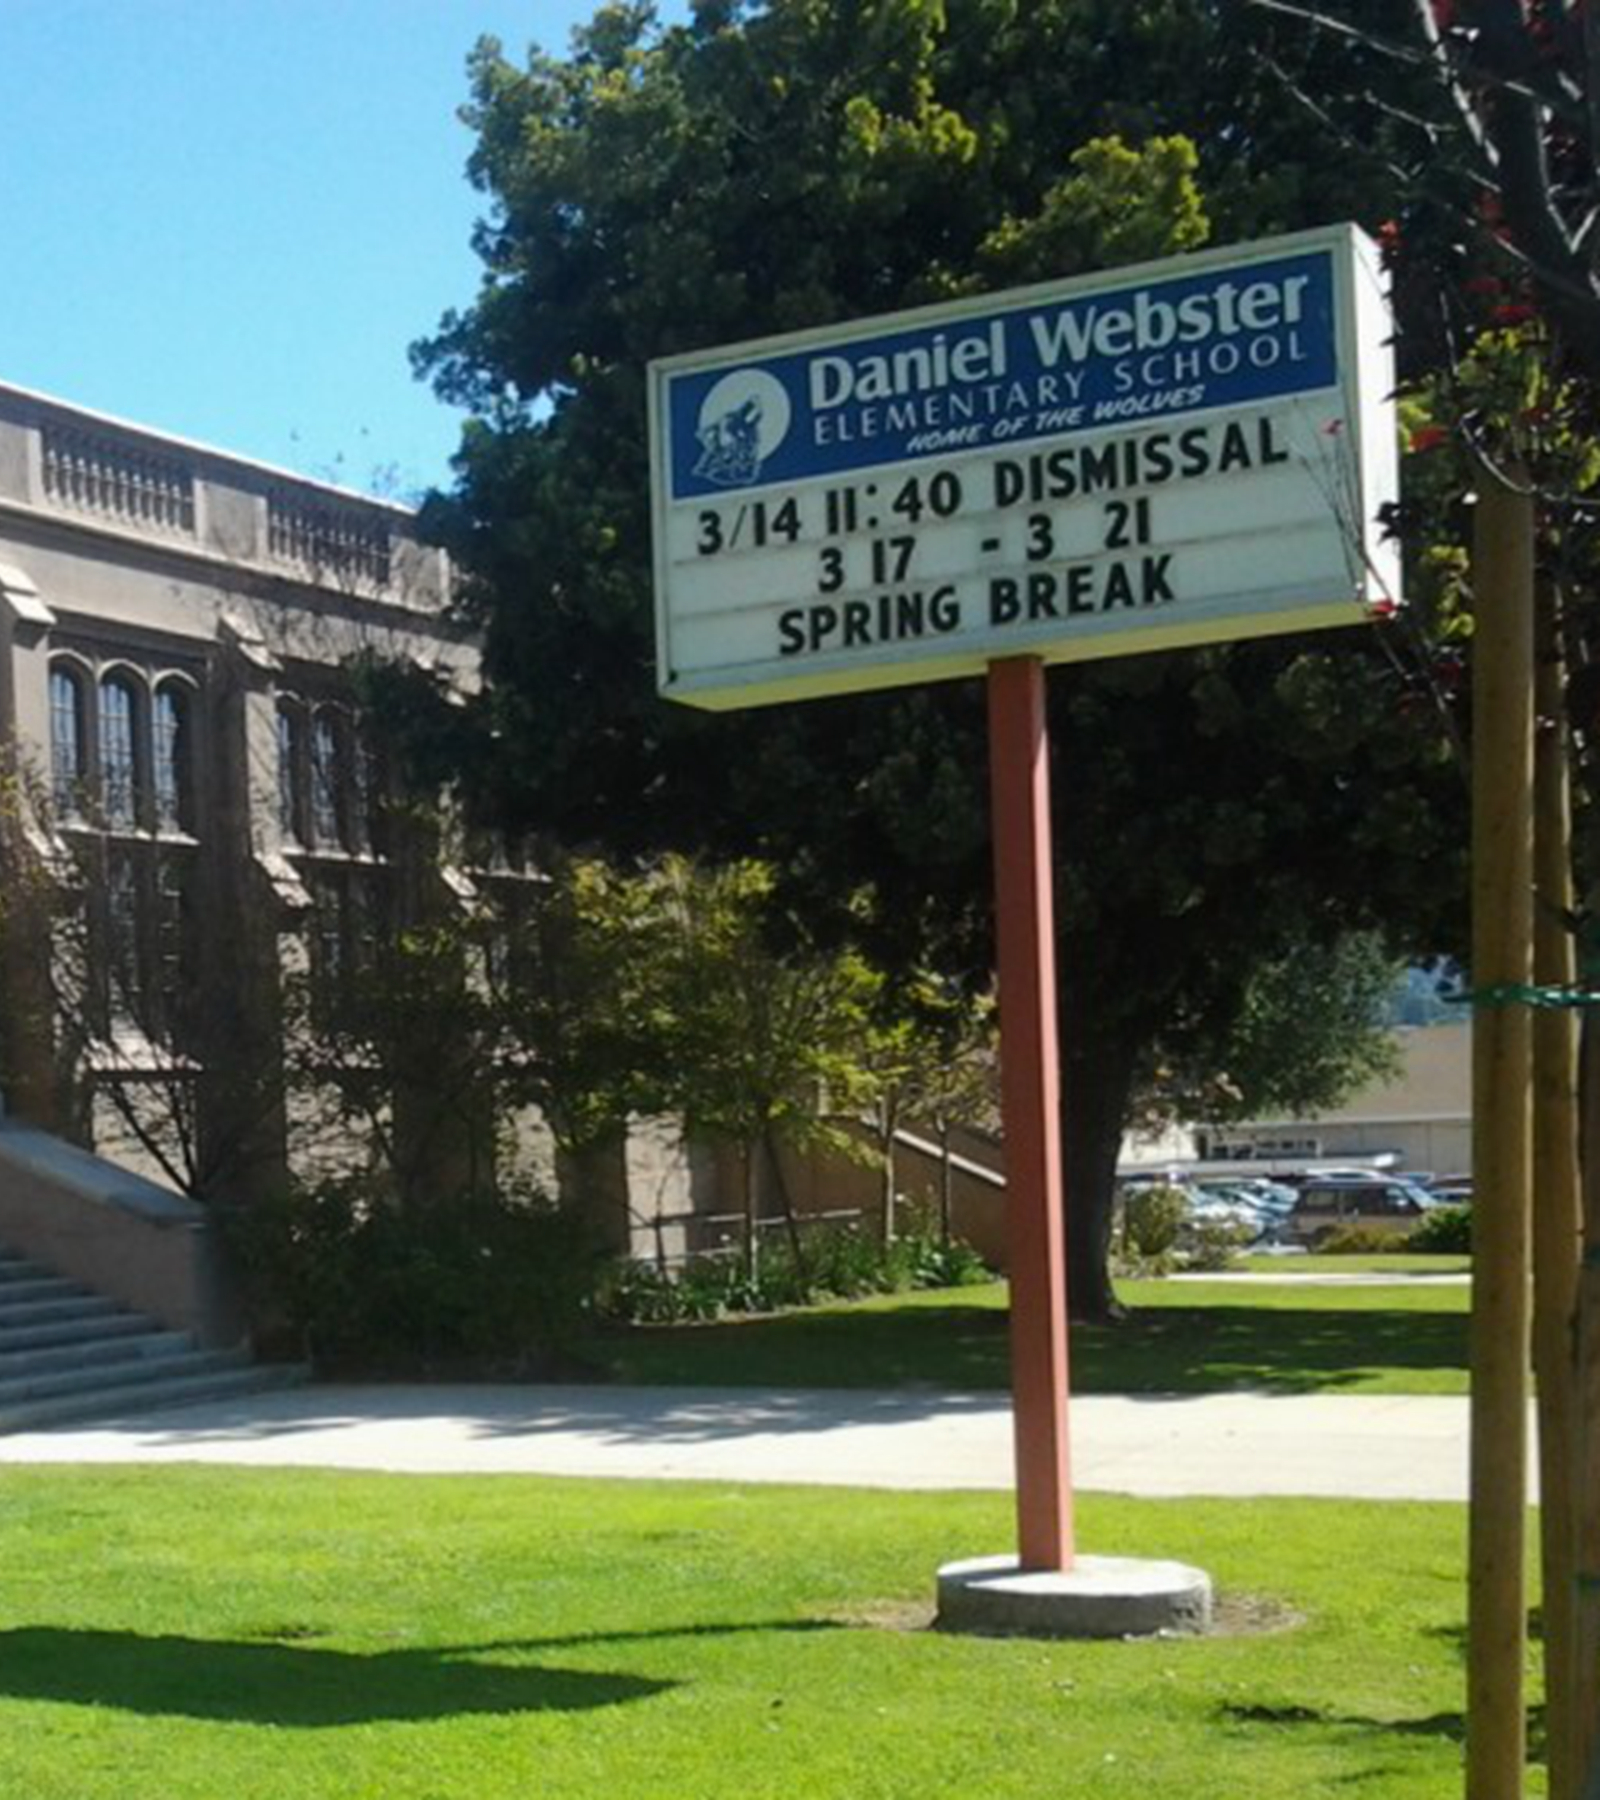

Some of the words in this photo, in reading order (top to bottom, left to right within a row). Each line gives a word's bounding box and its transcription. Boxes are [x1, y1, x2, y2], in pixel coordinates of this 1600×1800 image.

[809, 321, 1008, 411] Daniel
[1031, 274, 1309, 368] Webster
[814, 369, 1085, 446] ELEMENTARY
[1112, 331, 1308, 396] SCHOOL
[906, 423, 983, 453] HOME
[991, 415, 1028, 442] OF
[1034, 407, 1086, 433] THE
[1093, 385, 1208, 424] WOLVES
[697, 498, 800, 556] 3/14
[826, 470, 962, 536] 11:40
[993, 416, 1289, 508] DISMISSAL
[818, 547, 845, 594] 3
[871, 536, 917, 586] 17
[1025, 514, 1053, 562] 3
[1104, 496, 1152, 547] 21
[778, 587, 961, 657] SPRING
[989, 554, 1174, 627] BREAK
